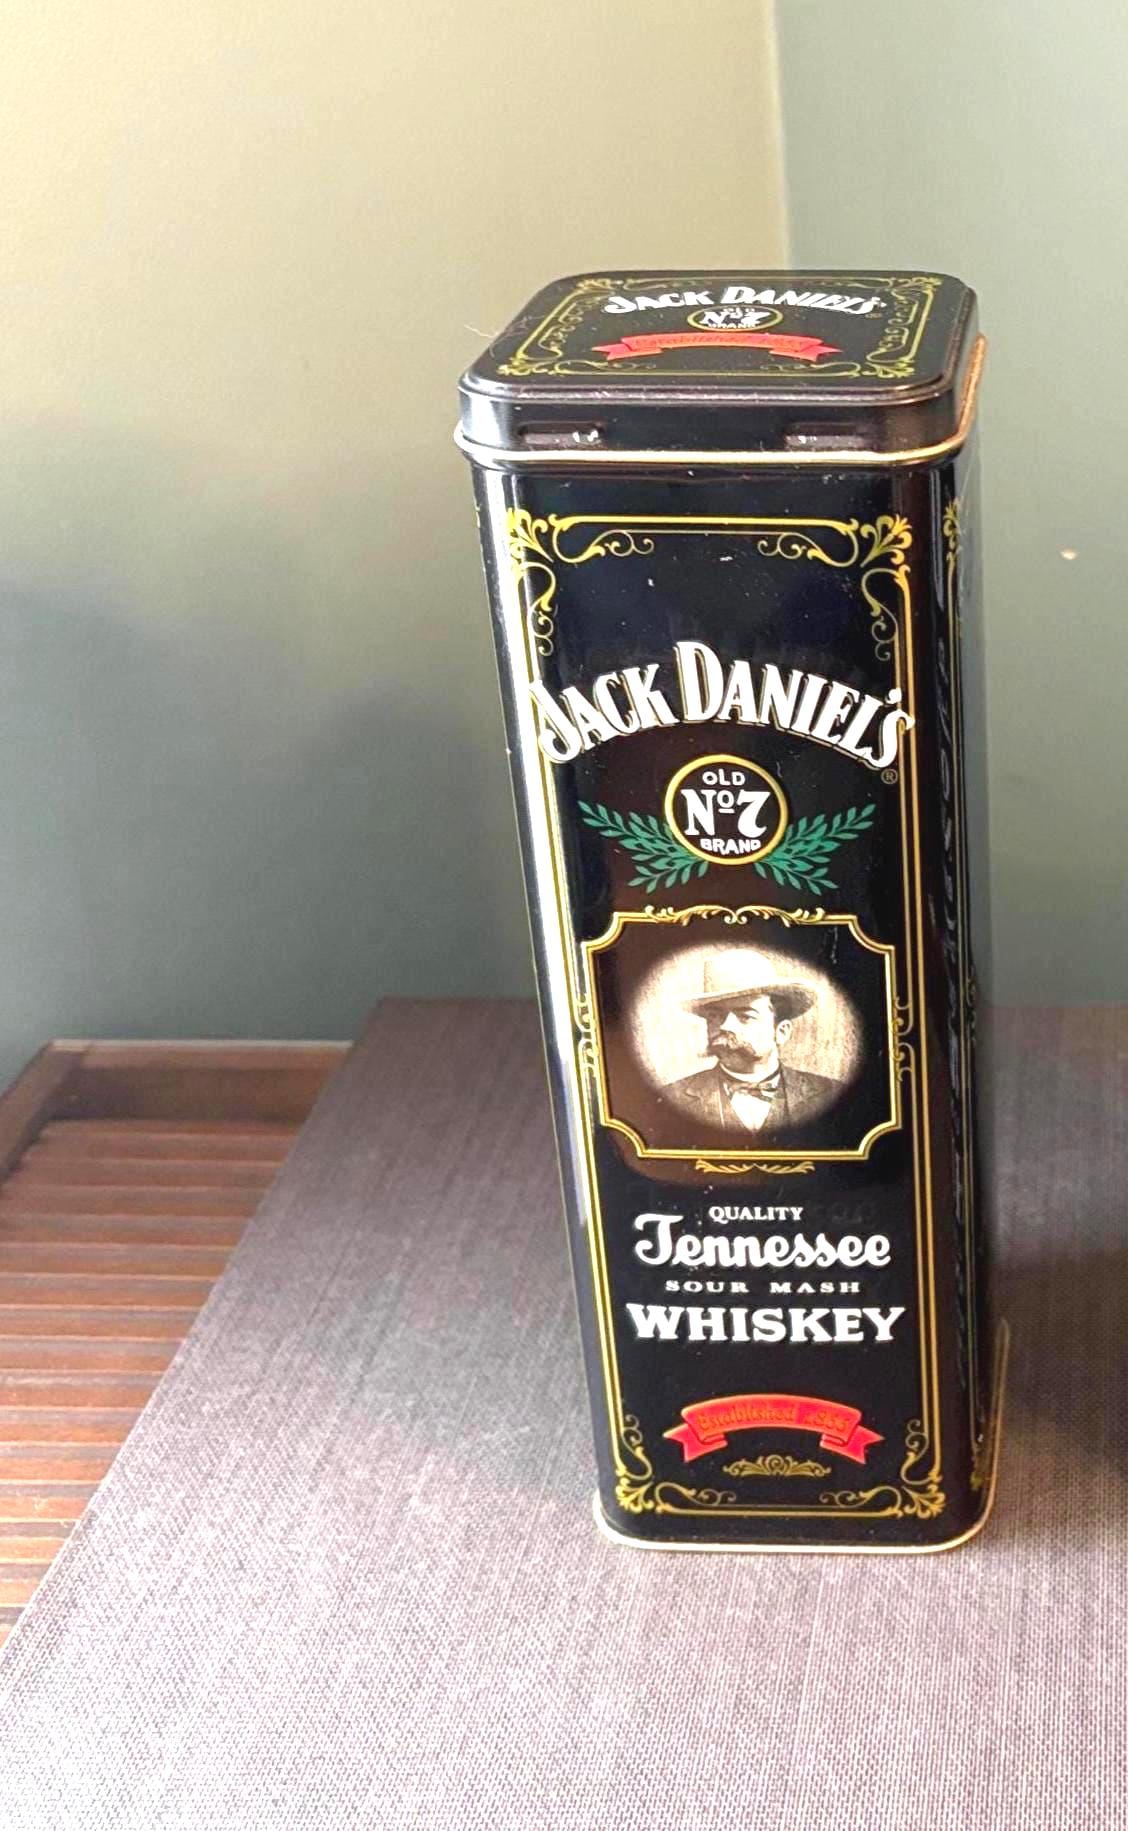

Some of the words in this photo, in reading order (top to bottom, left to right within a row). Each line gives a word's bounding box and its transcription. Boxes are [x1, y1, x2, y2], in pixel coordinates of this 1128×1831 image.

[604, 290, 715, 314] JACK
[529, 663, 679, 764] JACK
[702, 768, 745, 786] OLD
[700, 837, 762, 855] BRAND
[709, 1206, 803, 1224] QUALITY
[634, 1213, 891, 1267] Tennessee
[665, 1280, 749, 1294] SOUR
[769, 1281, 861, 1295] MASH
[625, 1303, 906, 1342] WHISKEY
